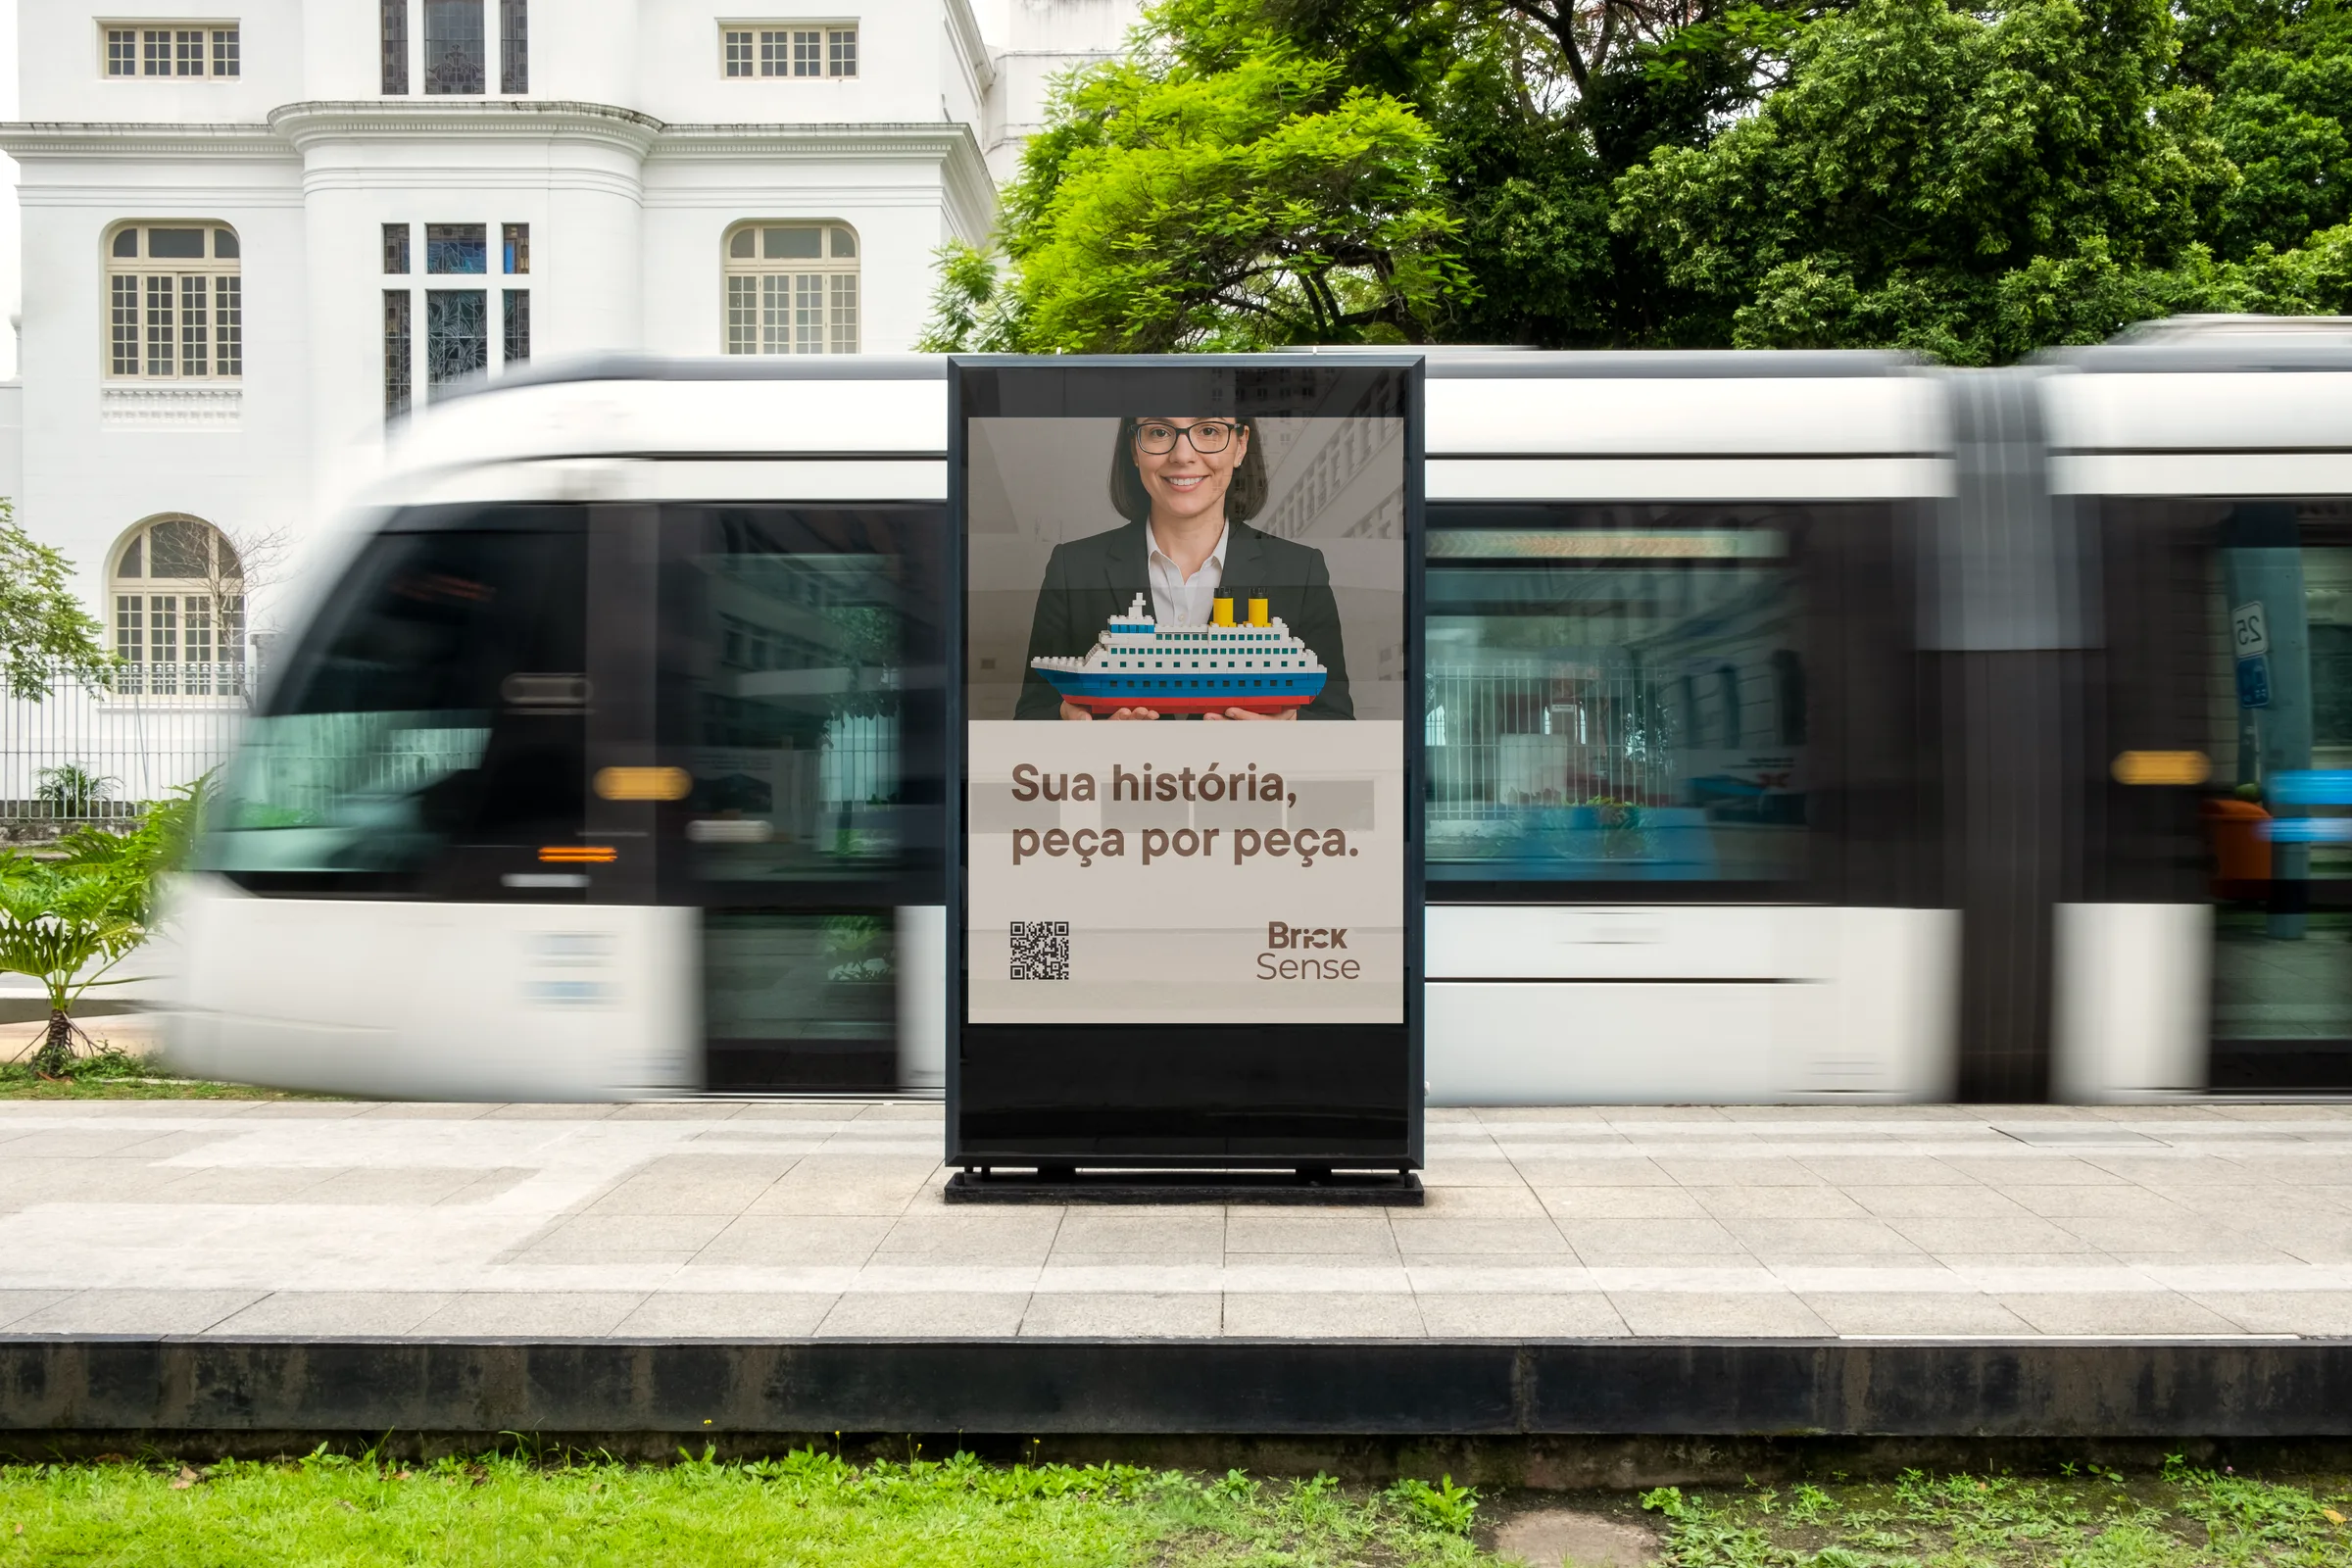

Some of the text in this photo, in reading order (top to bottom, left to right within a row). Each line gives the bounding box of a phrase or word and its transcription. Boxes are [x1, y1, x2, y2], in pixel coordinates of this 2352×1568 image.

[1011, 762, 1298, 809] Sua história,
[1012, 827, 1359, 868] peça por peça.
[1256, 952, 1361, 981] Sense
